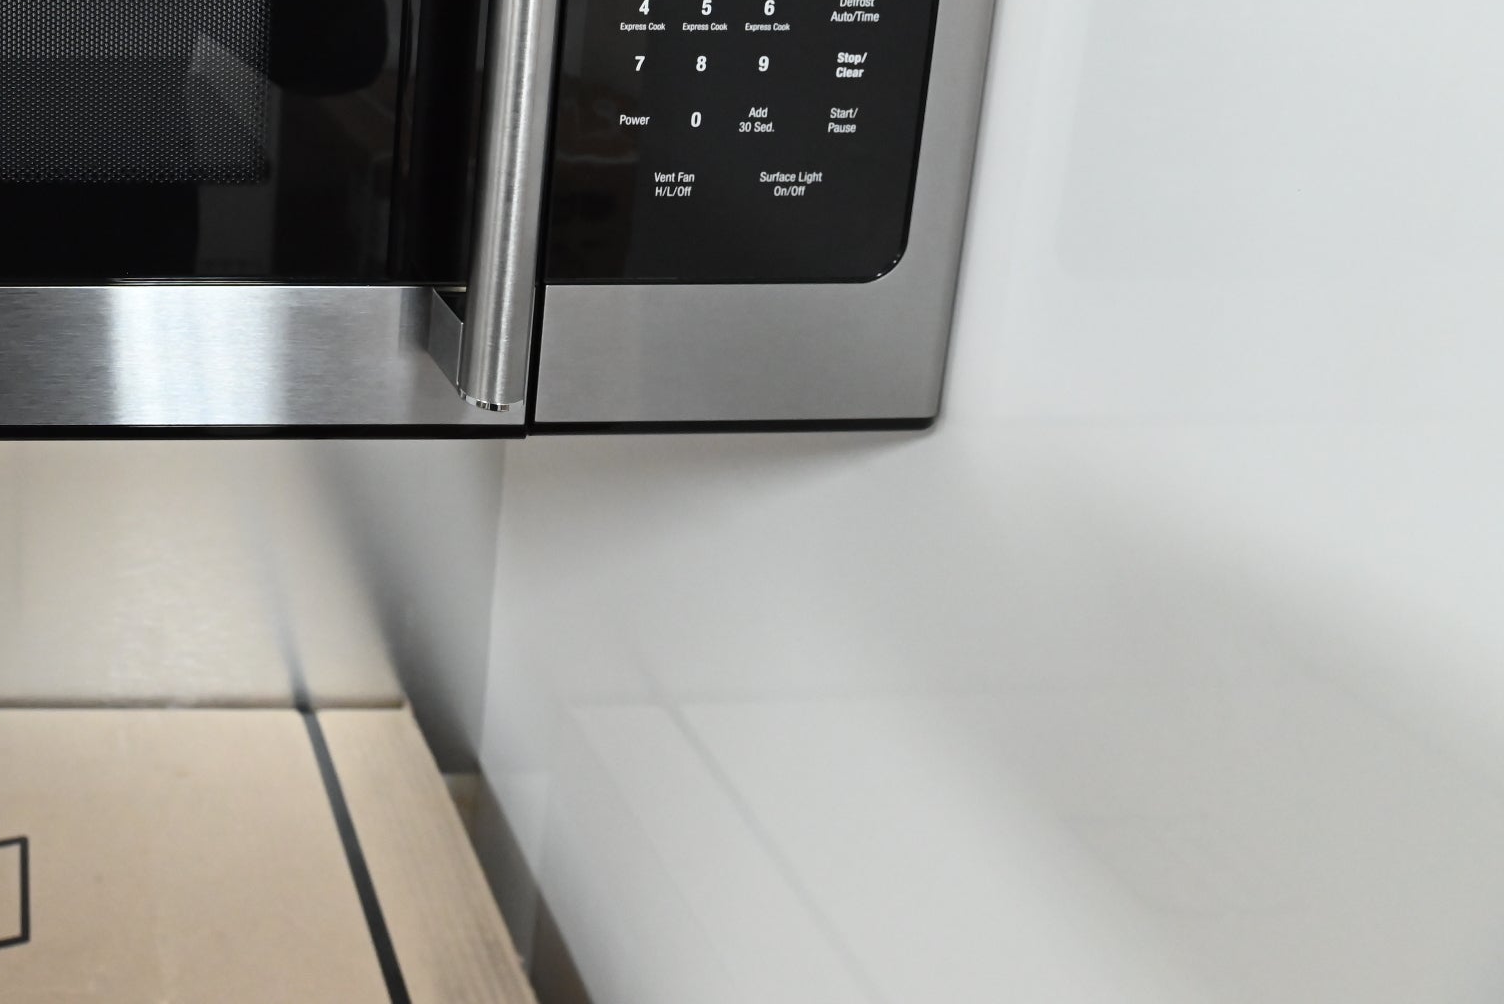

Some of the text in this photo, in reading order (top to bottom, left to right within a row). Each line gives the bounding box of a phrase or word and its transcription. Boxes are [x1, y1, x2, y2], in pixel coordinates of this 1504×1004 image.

[829, 10, 880, 23] Auto/Time
[619, 21, 666, 33] Express Cook
[681, 21, 728, 33] Express Cook
[744, 21, 791, 33] Express Cook
[634, 55, 646, 73] 7
[695, 55, 707, 73] 8
[758, 55, 770, 73] 9
[836, 51, 868, 66] Stop/
[835, 66, 865, 79] Clear
[747, 106, 769, 119] Add
[829, 107, 859, 119] Start/
[619, 114, 651, 126] Power
[690, 111, 702, 128] 0
[738, 121, 753, 133] 30
[827, 121, 857, 134] Pause
[653, 171, 696, 183] Vent Fan
[759, 171, 823, 185] Surface Light
[654, 185, 693, 197] H/L/Off
[773, 185, 806, 197] On/Off
